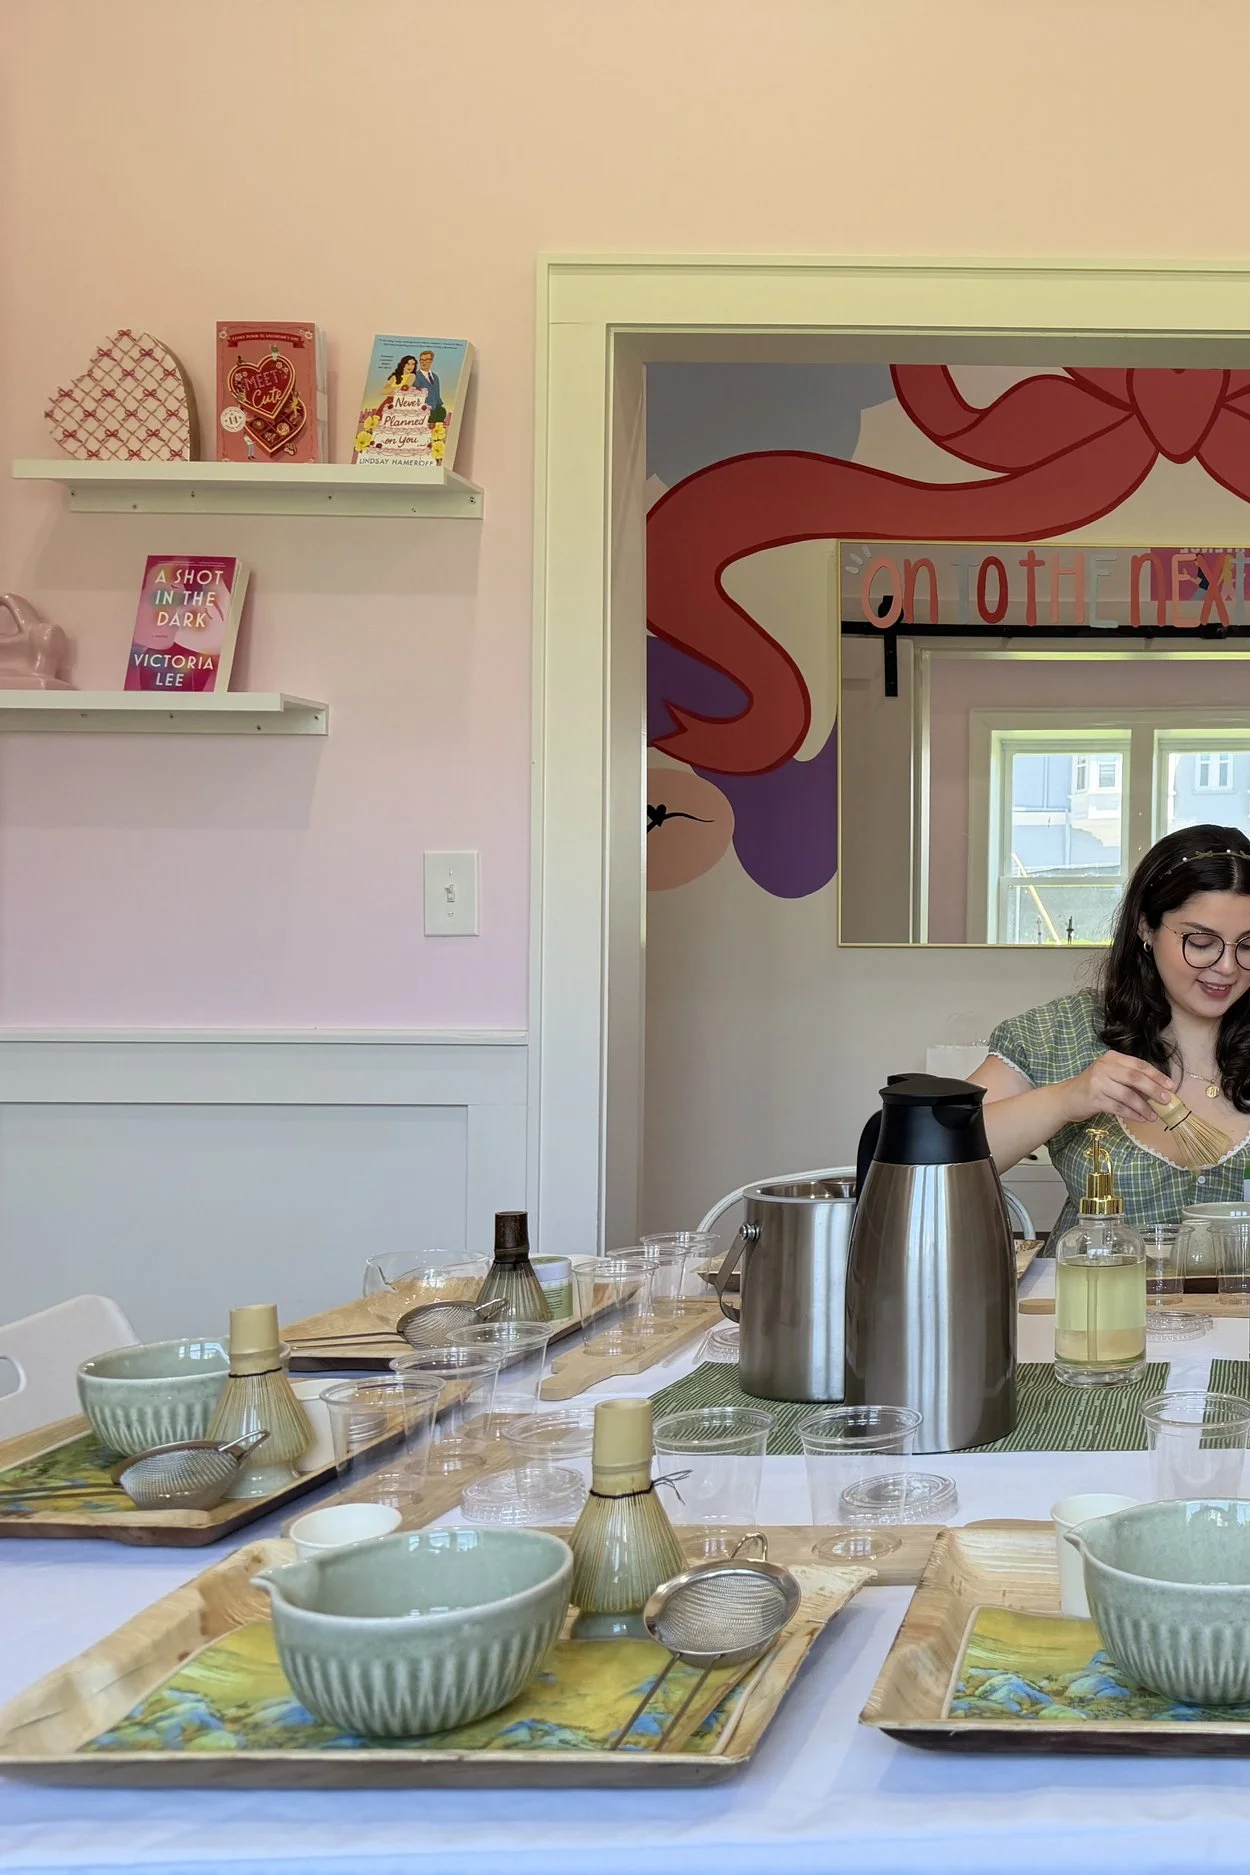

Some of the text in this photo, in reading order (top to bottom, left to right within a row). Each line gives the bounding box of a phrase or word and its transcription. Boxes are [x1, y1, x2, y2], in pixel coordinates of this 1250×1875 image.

[243, 369, 279, 391] MEET
[252, 386, 283, 409] Cute
[394, 397, 421, 408] Never
[383, 415, 427, 427] Planned
[383, 437, 397, 445] on
[391, 458, 434, 467] HAMEROFF
[155, 569, 223, 585] A SHOT
[155, 590, 215, 606] IN THE
[157, 611, 207, 628] DARK
[134, 653, 214, 670] VICTORIA
[155, 672, 184, 687] LEE
